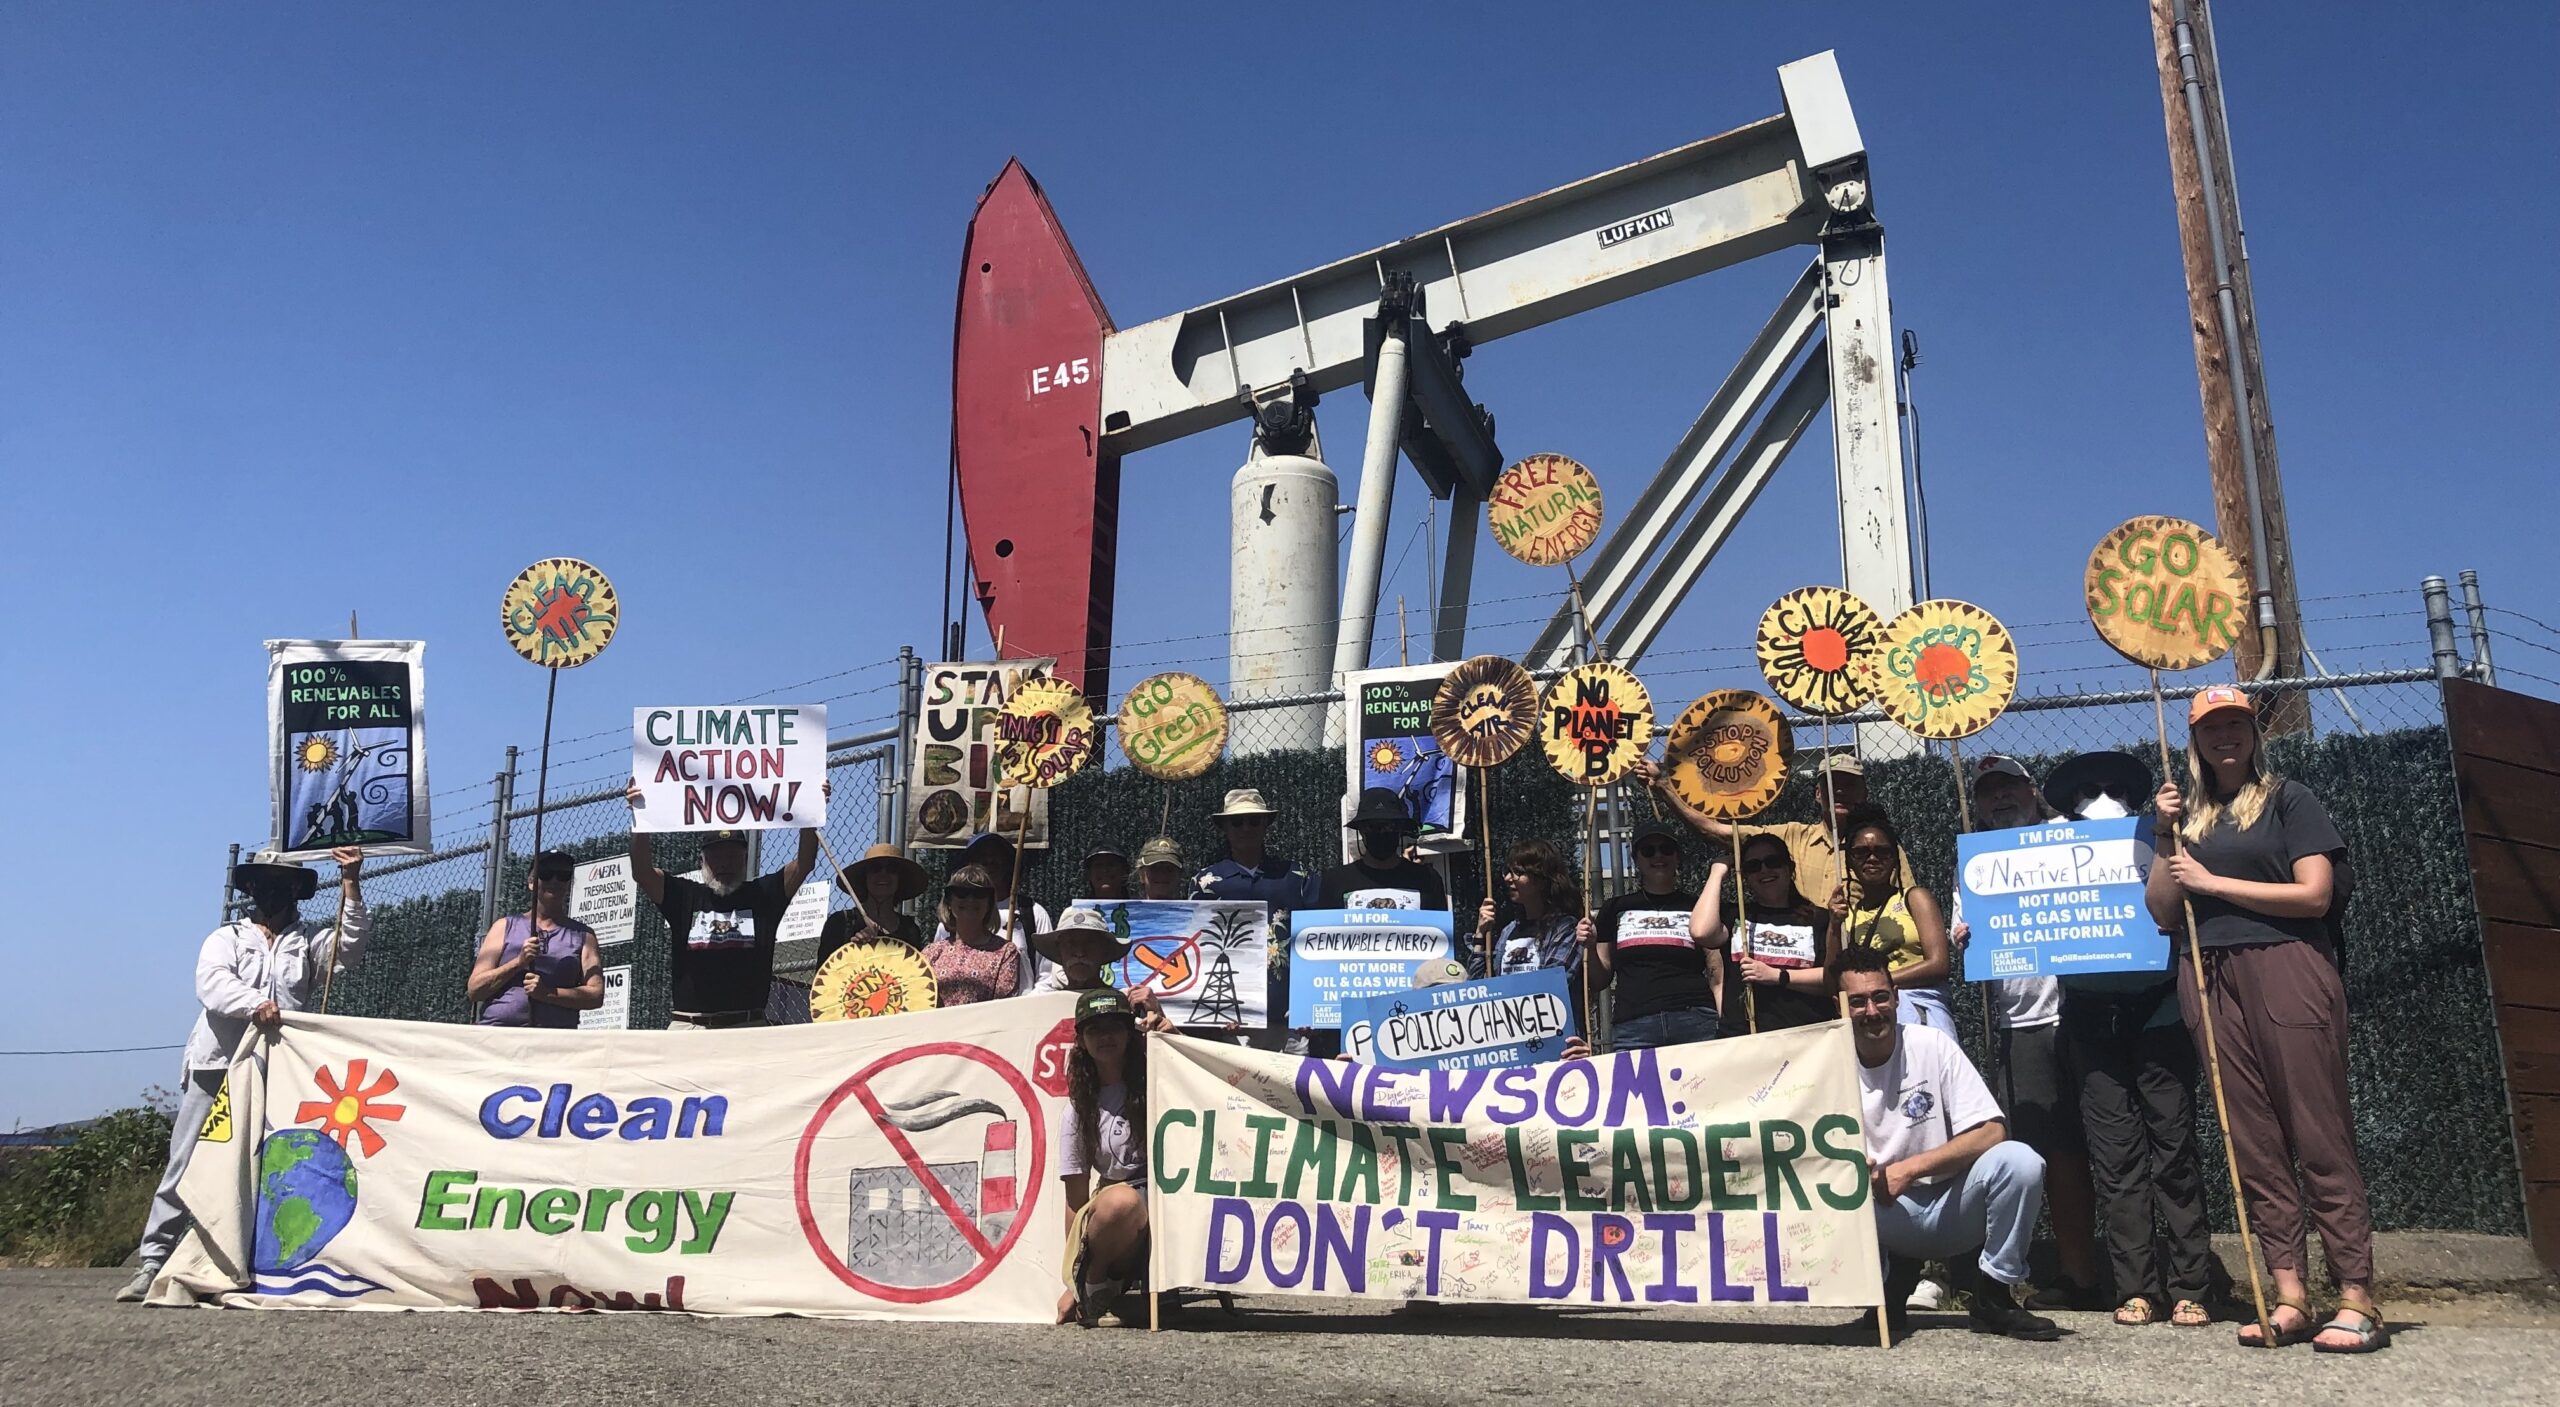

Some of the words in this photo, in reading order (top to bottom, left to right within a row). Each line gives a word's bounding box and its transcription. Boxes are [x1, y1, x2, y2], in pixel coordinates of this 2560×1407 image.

[1601, 211, 1670, 246] LUFKIN
[1033, 358, 1090, 394] E45
[1496, 455, 1561, 510] FREE
[1498, 481, 1600, 544] NATURAL
[1527, 505, 1600, 562] ENERGY
[2119, 529, 2198, 577] GO
[2093, 568, 2236, 648] SOLAR
[541, 603, 614, 660] AIR
[1777, 600, 1876, 659] CLIMATE
[1769, 636, 1868, 701] JUSTICE
[291, 685, 401, 703] RENEWABLES
[1131, 679, 1174, 719] GO
[1365, 700, 1433, 715] RENEWABL
[1460, 691, 1508, 720] CLEAN
[1576, 676, 1610, 709] NO
[327, 705, 360, 720] FOR
[369, 704, 400, 718] ALL
[646, 708, 799, 747] CLIMATE
[928, 707, 1000, 742] UP
[1393, 717, 1420, 730] FOR
[1469, 714, 1511, 738] AIR
[1553, 706, 1641, 740] PLANET
[1130, 702, 1212, 764] Green
[655, 747, 785, 784] ACTION
[1015, 727, 1093, 784] SOLAR
[1690, 736, 1769, 783] POLLUTION
[684, 781, 803, 826] NOW!
[920, 788, 1033, 834] OIL
[2019, 831, 2043, 845] I'M
[2046, 828, 2090, 841] FOR...
[2071, 845, 2149, 886] PLANTS
[578, 899, 592, 912] AND
[593, 894, 628, 910] LOITERING
[584, 880, 626, 898] TRESPASSING
[2018, 894, 2050, 909] NOT
[2054, 890, 2100, 905] MORE
[609, 909, 618, 921] BY
[619, 907, 634, 919] LAW
[1344, 914, 1363, 924] I'M
[1366, 913, 1400, 923] FOR...
[1990, 914, 2017, 929] OIL
[2021, 912, 2032, 926] &
[2036, 909, 2071, 925] GAS
[2074, 905, 2136, 922] WELLS
[1304, 932, 1383, 952] RENEWABLE
[1385, 932, 1438, 953] ENERGY
[1767, 947, 1786, 955] FOSSIL
[1788, 949, 1805, 957] FUELS
[2002, 931, 2020, 945] IN
[2023, 924, 2124, 943] CALIFORNIA
[1340, 963, 1366, 973] NOT
[1368, 963, 1405, 973] MORE
[1994, 951, 2014, 960] LAST
[1994, 957, 2027, 966] CHANCE
[1994, 964, 2034, 973] ALLIANCE
[1313, 977, 1337, 988] OIL
[1341, 976, 1350, 988] &
[1353, 976, 1382, 988] GAS
[1323, 990, 1338, 1001] IN
[1432, 990, 1456, 1006] I'M
[1459, 985, 1502, 1001] FOR...
[1390, 1008, 1466, 1056] POLICY
[1468, 994, 1564, 1044] CHANGE!
[1039, 1042, 1076, 1079] ST
[1438, 1056, 1470, 1071] NOT
[1473, 1048, 1519, 1066] MORE
[1295, 1048, 1687, 1127] NEWSOM:
[478, 1083, 729, 1142] Clean
[1153, 1109, 1477, 1211] CLIMATE
[1504, 1114, 1870, 1211] LEADERS
[414, 1169, 736, 1255] Energy
[1463, 1218, 1489, 1231] TRACY
[1204, 1197, 1461, 1297] DON'T
[1529, 1212, 1809, 1302] DRILL
[1583, 1248, 1591, 1288] JUSTINE
